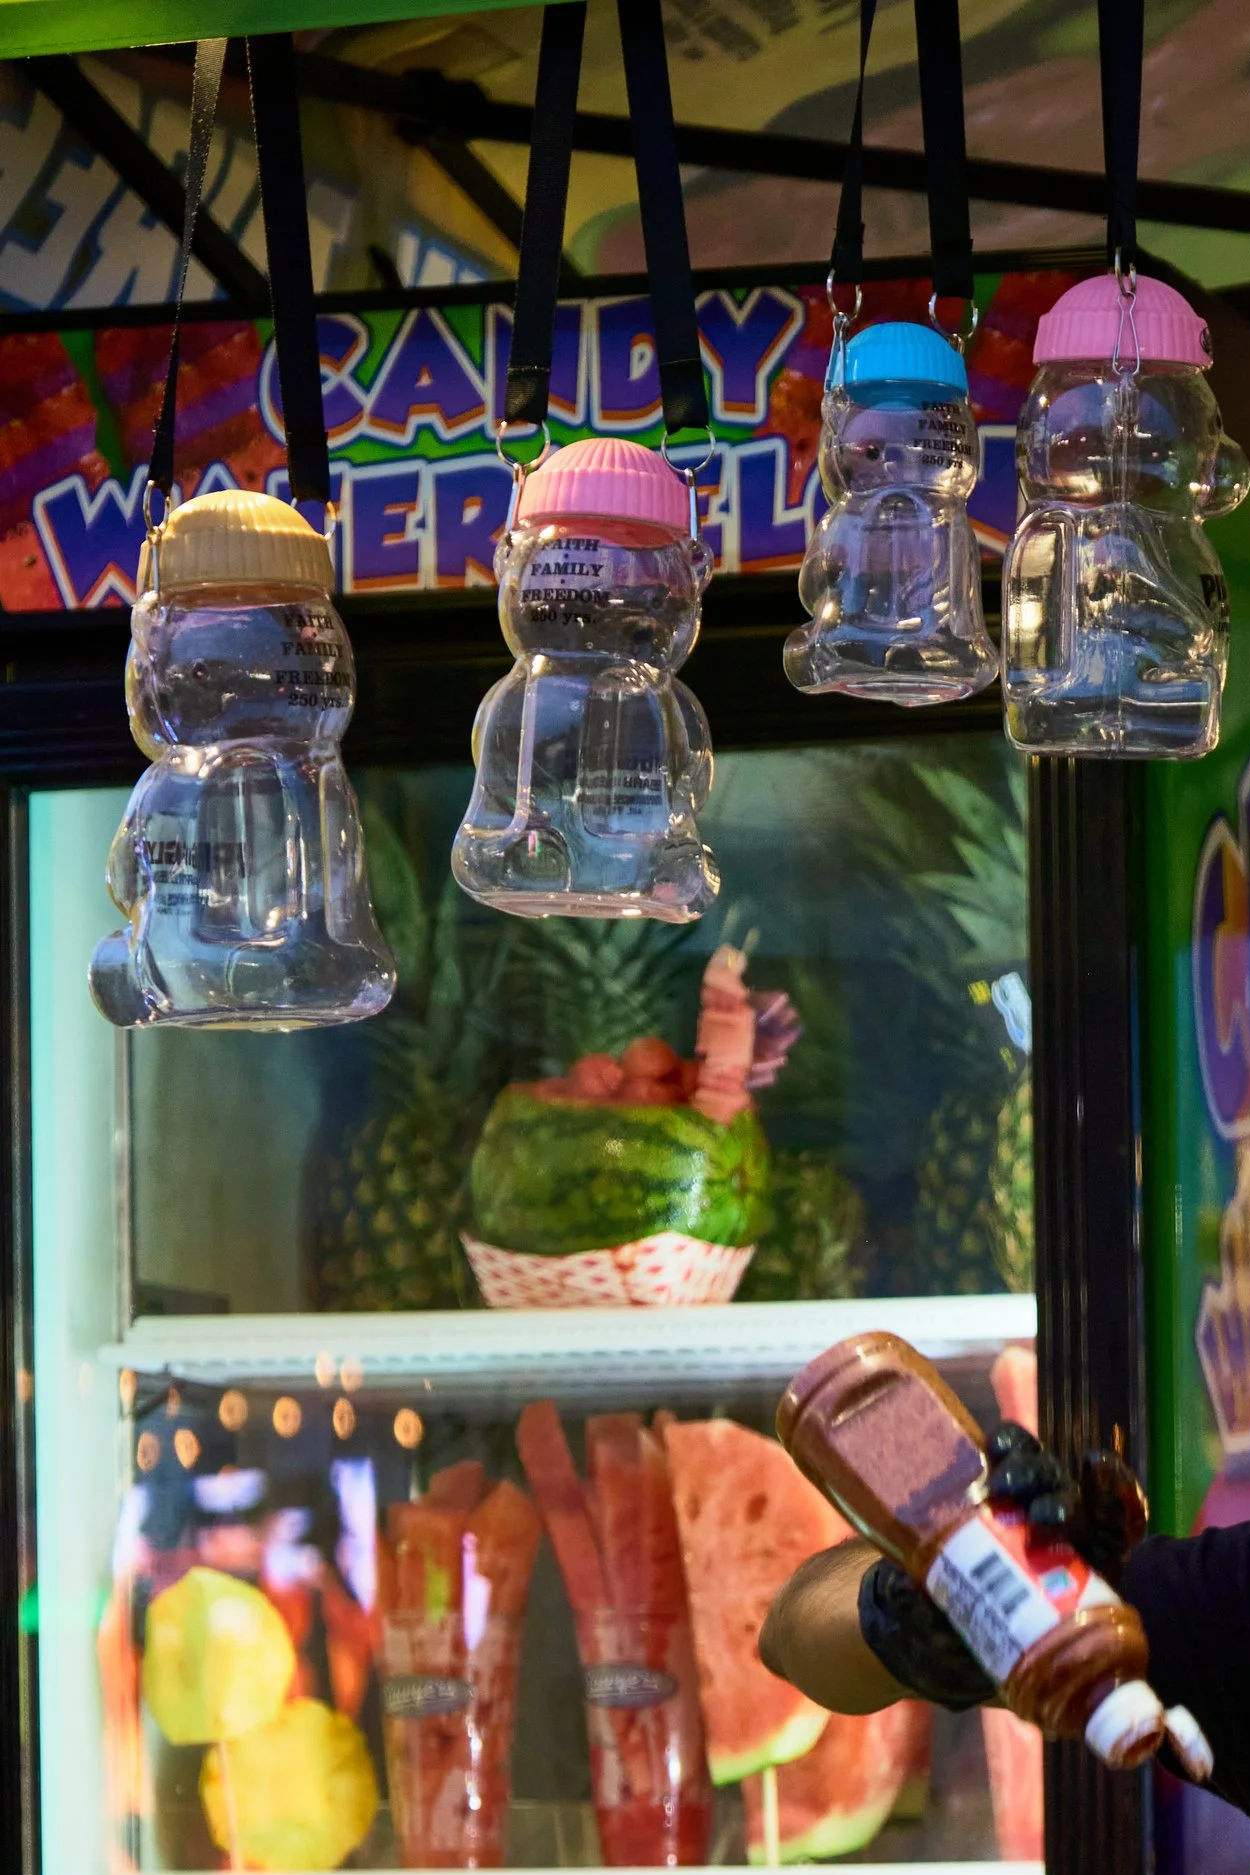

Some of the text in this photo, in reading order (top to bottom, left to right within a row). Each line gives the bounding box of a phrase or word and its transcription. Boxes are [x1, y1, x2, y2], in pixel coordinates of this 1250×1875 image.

[261, 288, 804, 447] CANDY
[918, 419, 966, 434] FAMILY
[913, 438, 972, 455] FREEDOM
[540, 537, 600, 552] FAITH
[530, 562, 604, 577] FAMILY
[521, 587, 611, 607] FREEDOM
[531, 610, 557, 623] 250
[281, 641, 344, 657] FAMILY
[287, 692, 318, 708] 250
